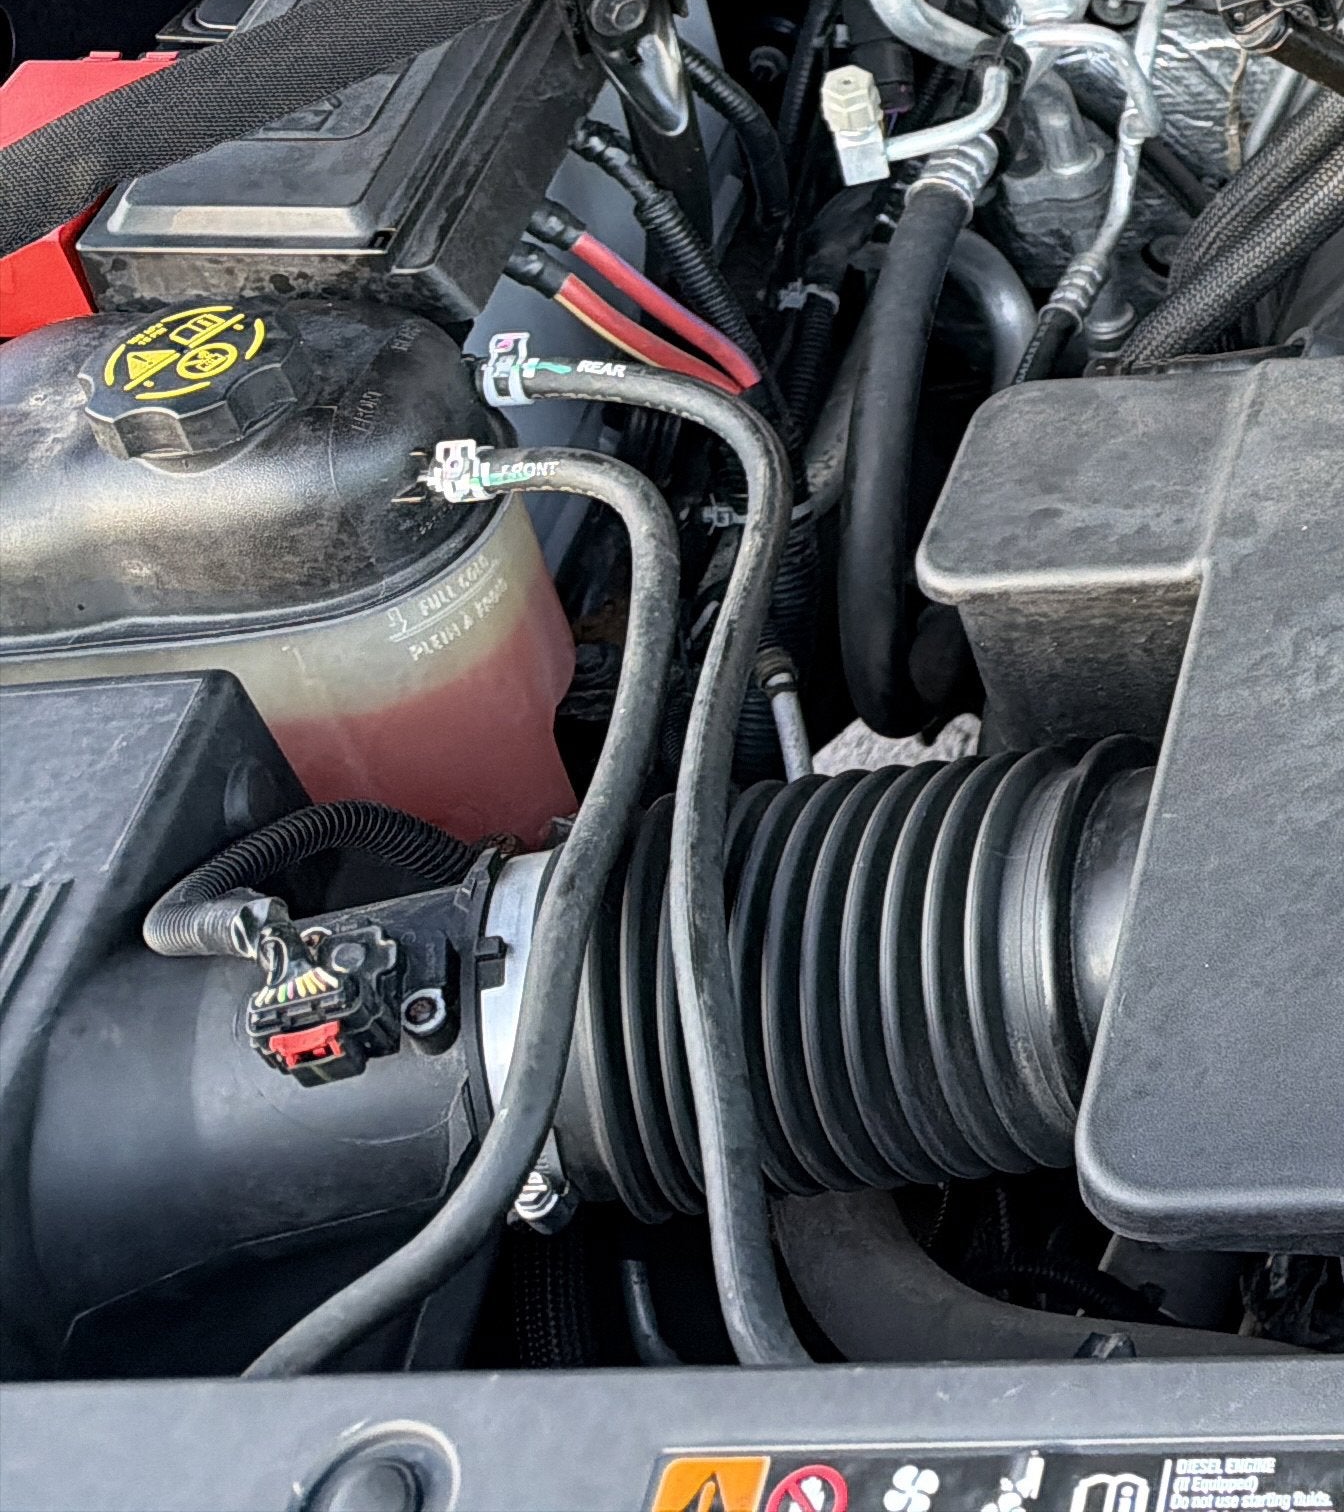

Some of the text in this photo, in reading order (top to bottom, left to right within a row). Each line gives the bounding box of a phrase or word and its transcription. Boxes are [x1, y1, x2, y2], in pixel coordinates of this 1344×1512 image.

[577, 359, 627, 378] REAR
[499, 461, 560, 477] FRONT
[418, 585, 457, 617] FULL
[408, 622, 462, 661] PLEIN
[1175, 1457, 1277, 1475] DIESEL ENGINE
[1169, 1494, 1190, 1510] Do
[1190, 1494, 1214, 1509] not
[1214, 1495, 1240, 1509] use
[1240, 1492, 1291, 1510] starting
